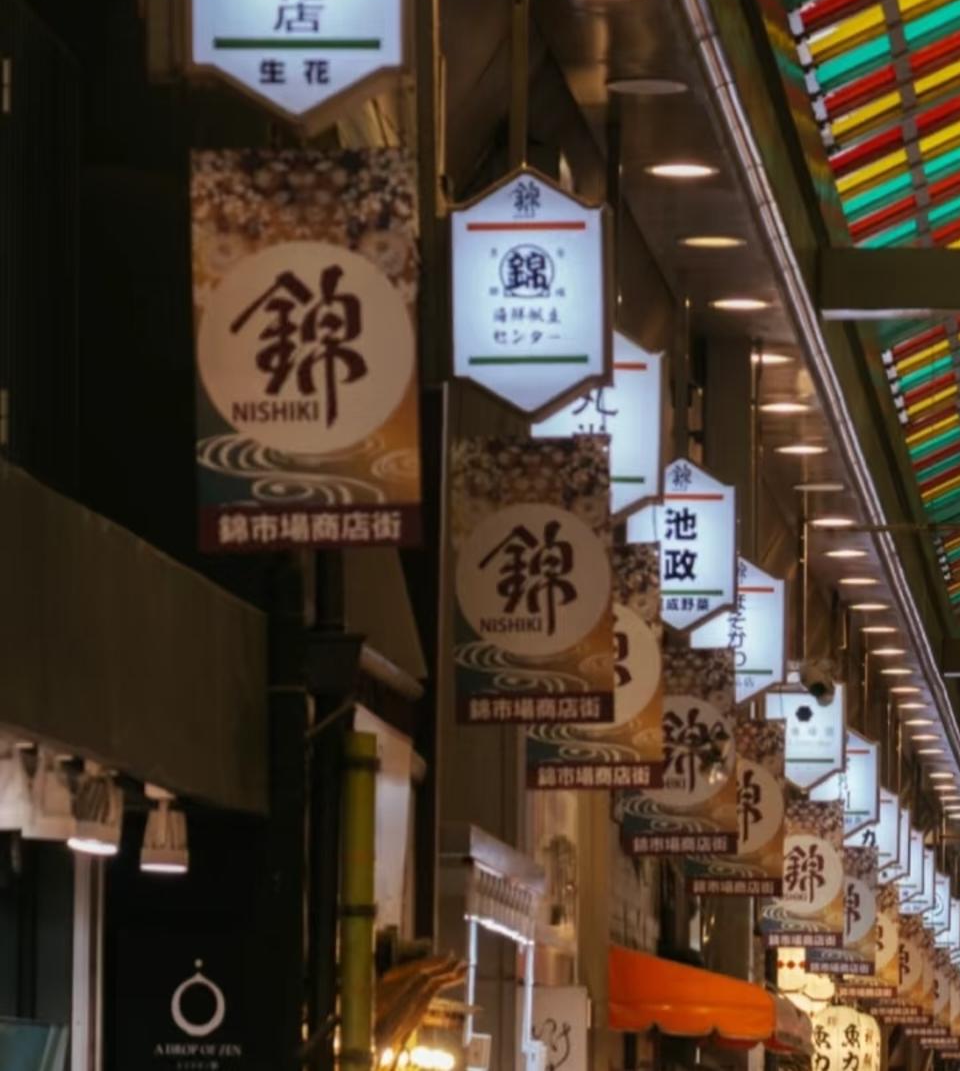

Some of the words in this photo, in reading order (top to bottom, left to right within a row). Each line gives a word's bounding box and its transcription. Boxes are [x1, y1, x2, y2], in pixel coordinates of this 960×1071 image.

[259, 60, 330, 85] 生花
[506, 251, 550, 292] 錦
[229, 263, 369, 429] 錦
[493, 330, 561, 345] センター
[231, 401, 319, 423] NISHIKI
[220, 512, 400, 543] 錦市場商店街
[664, 508, 697, 581] 池政
[478, 520, 578, 636] 錦
[662, 598, 709, 611] 成野菜
[479, 617, 543, 634] NISHIKI
[470, 697, 600, 719] 錦市場商店街
[539, 766, 650, 786] 錦市場商店街
[784, 843, 826, 903] 錦
